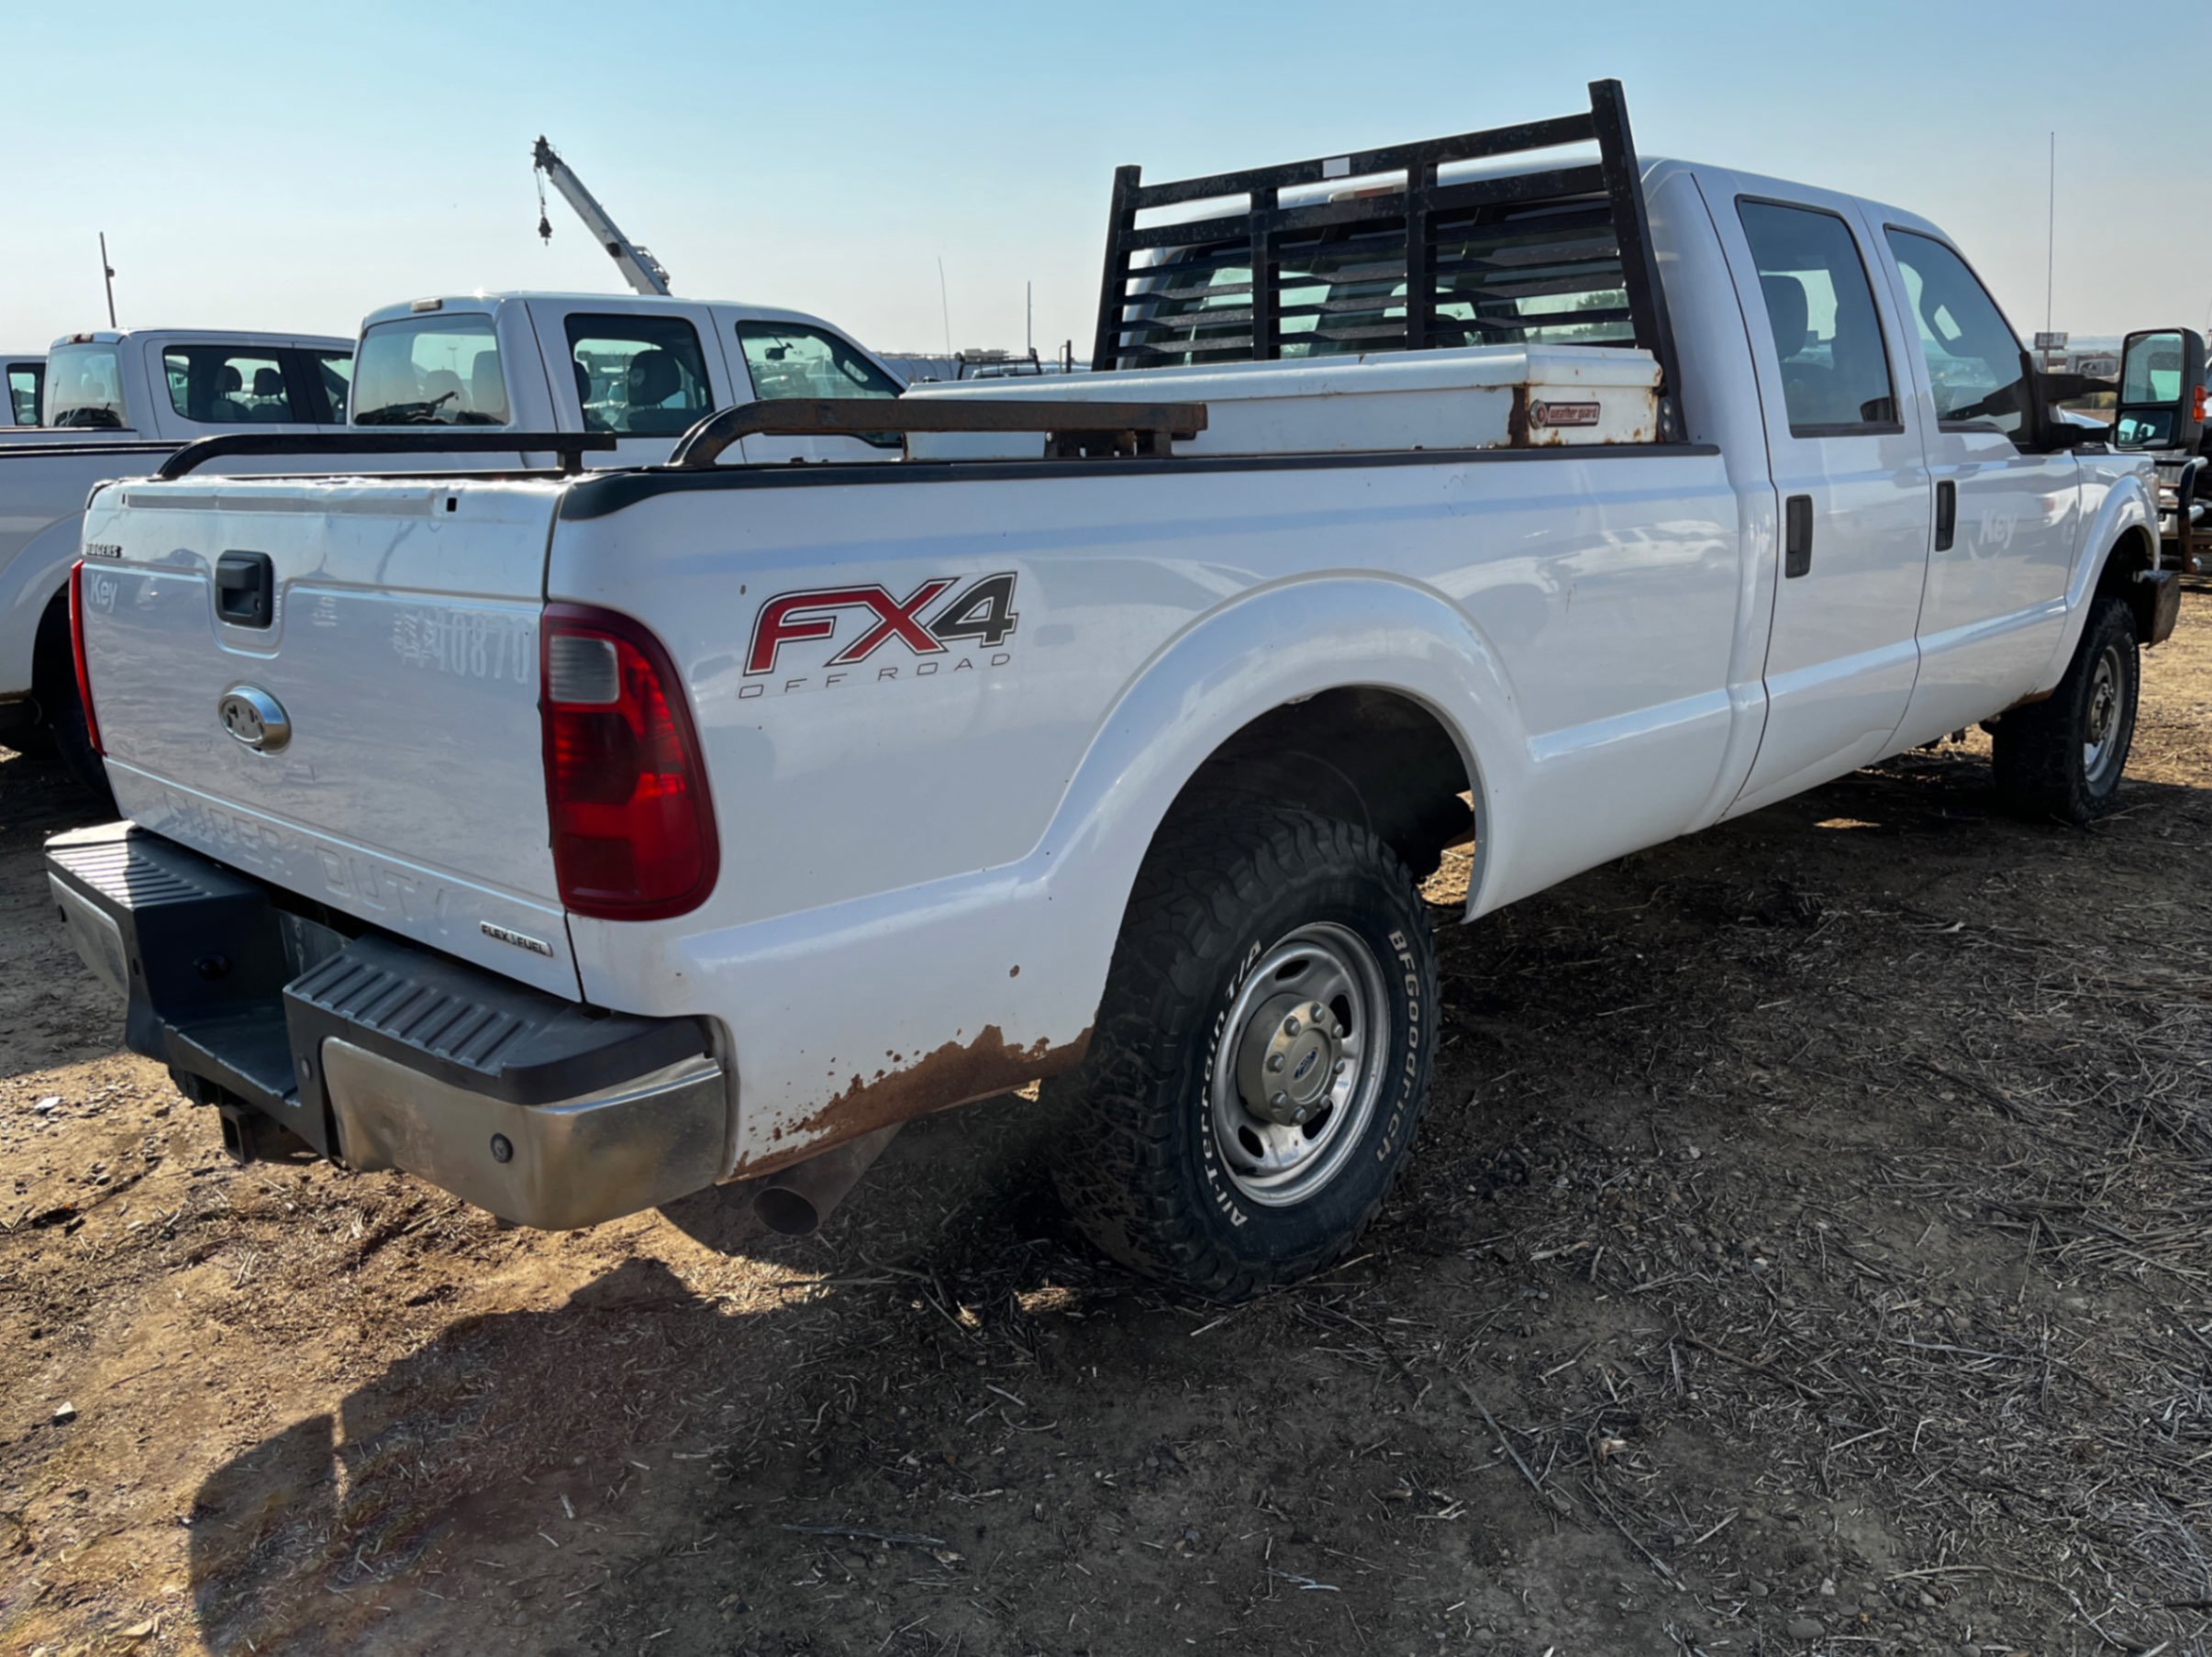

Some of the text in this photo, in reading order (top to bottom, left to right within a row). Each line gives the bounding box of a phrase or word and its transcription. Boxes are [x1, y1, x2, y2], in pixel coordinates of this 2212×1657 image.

[90, 573, 118, 614] Key
[742, 571, 1018, 677] FX4
[516, 936, 547, 956] FUEL
[1224, 940, 1262, 1002] T/A
[1376, 929, 1420, 1162] BFGoodrich
